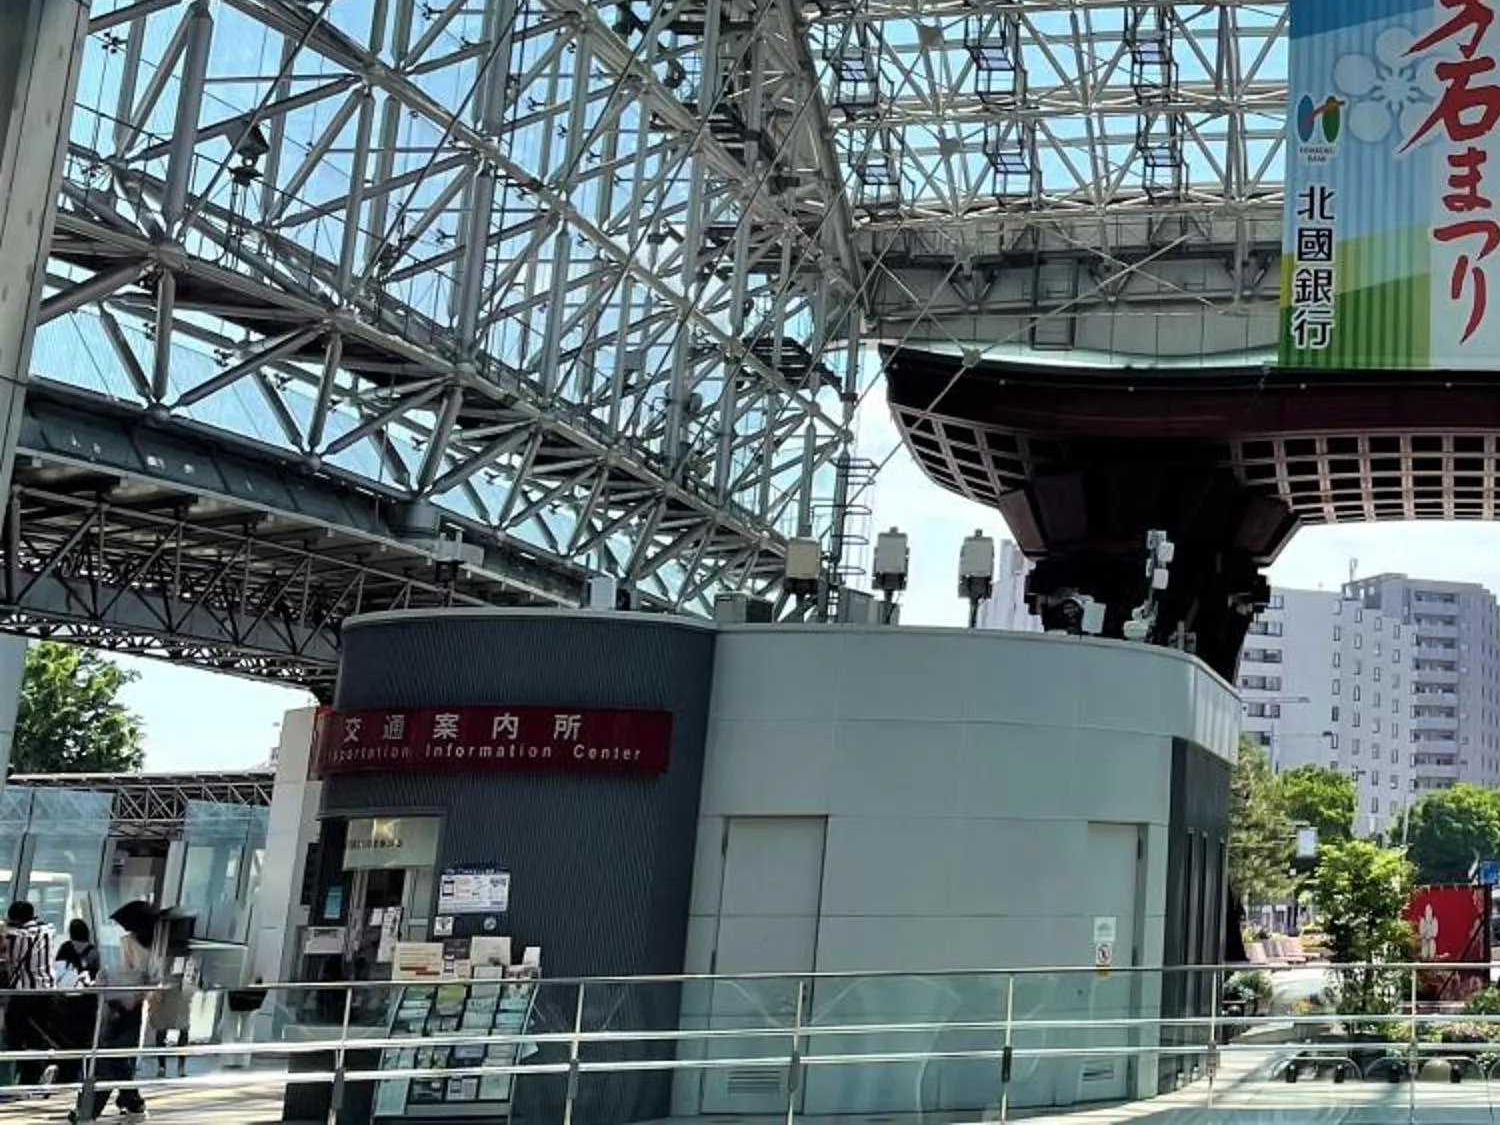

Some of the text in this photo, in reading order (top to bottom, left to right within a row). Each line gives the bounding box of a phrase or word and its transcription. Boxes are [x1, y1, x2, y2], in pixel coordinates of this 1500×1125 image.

[1294, 185, 1336, 347] 北國銀行
[343, 712, 583, 743] 交通案内所
[425, 742, 551, 759] Information
[573, 743, 641, 761] Center
